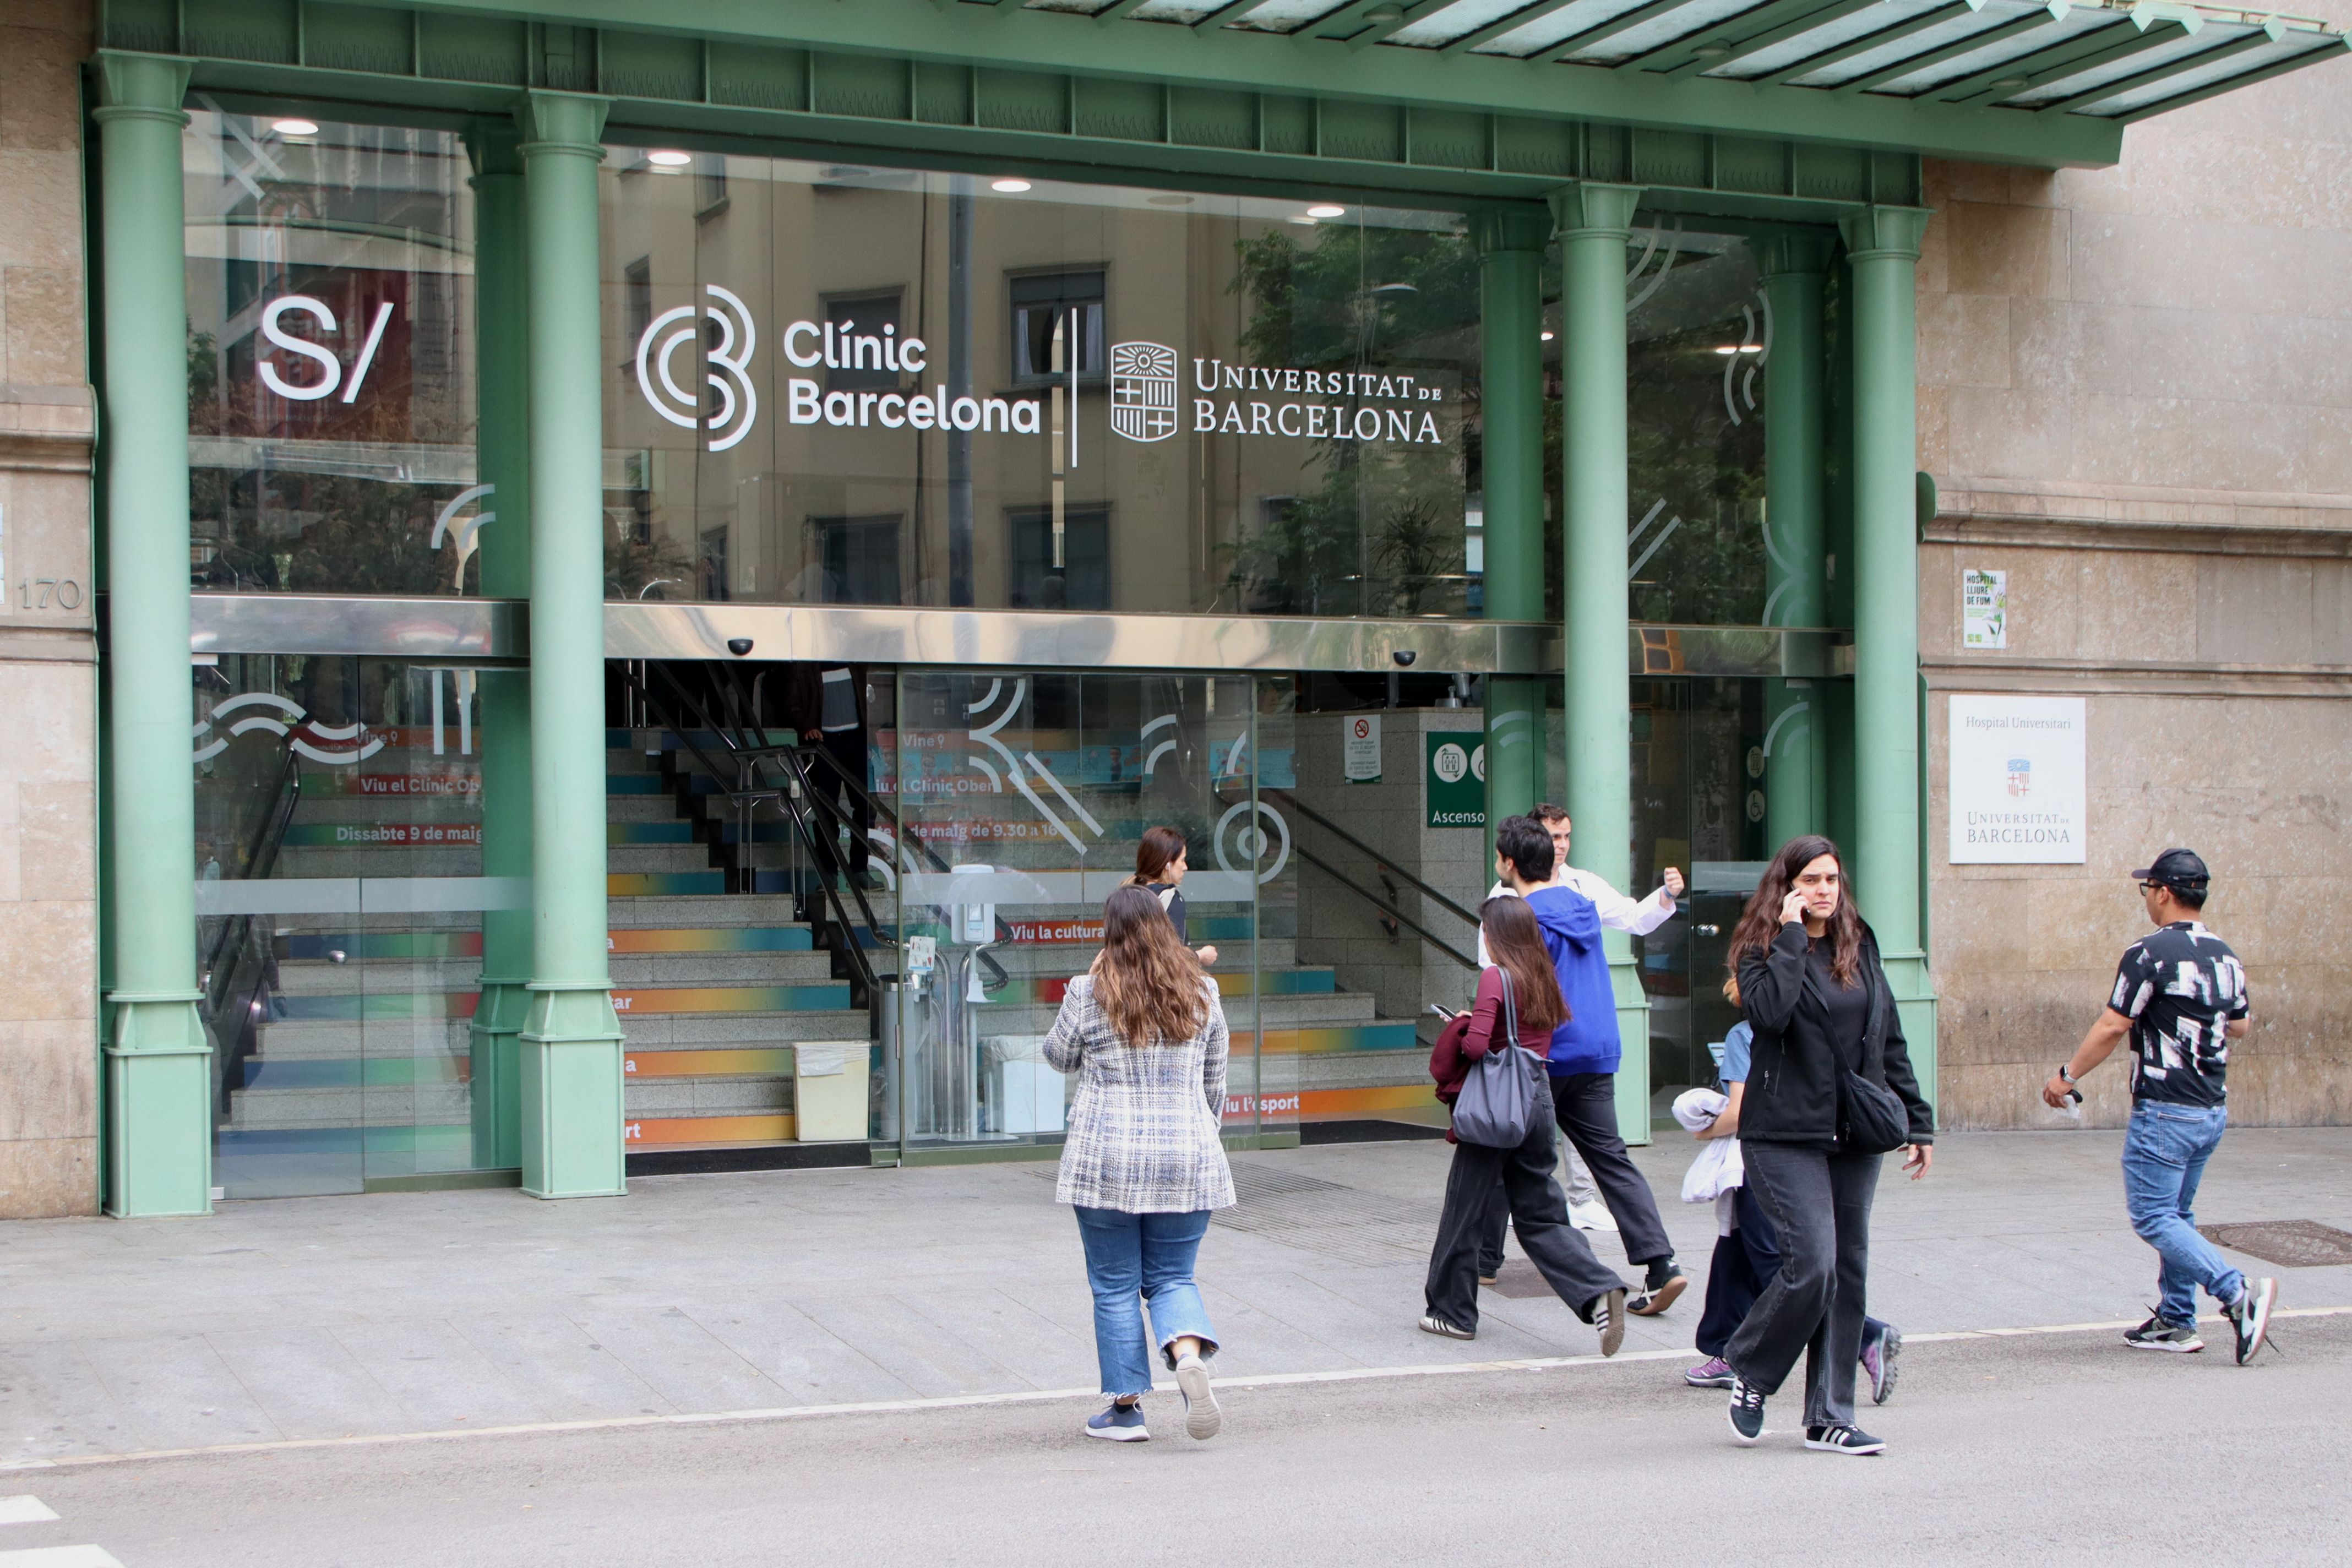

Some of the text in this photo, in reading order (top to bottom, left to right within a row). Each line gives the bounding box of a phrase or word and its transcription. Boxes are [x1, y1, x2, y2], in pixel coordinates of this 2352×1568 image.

[784, 319, 927, 373] Clínic
[1194, 358, 1442, 401] UNIVERSITAT DE
[788, 378, 1041, 434] Barcelona
[1194, 399, 1441, 443] BARCELONA
[1967, 575, 1997, 585] HOSPITAL
[19, 578, 83, 609] 170
[1967, 585, 1989, 595] LLIURE
[1967, 596, 1990, 605] DE FUM
[1966, 716, 2071, 731] Hospital Universitari
[902, 734, 935, 747] Vine
[361, 778, 387, 792] Viu
[391, 778, 405, 792] el
[409, 777, 454, 793] Clínic
[875, 779, 889, 792] iu
[910, 778, 953, 793] Clínic
[1433, 810, 1485, 823] Ascenso
[1968, 812, 2059, 825] UNIVERSITAT
[336, 826, 482, 843] Dissabte 9 de maig
[932, 824, 968, 841] maig
[971, 824, 989, 837] de
[993, 824, 1027, 837] 9.30
[1030, 827, 1038, 836] a
[1967, 829, 2070, 843] BARCELONA
[1010, 924, 1106, 940] Viu la cultura
[1225, 1097, 1239, 1113] iu
